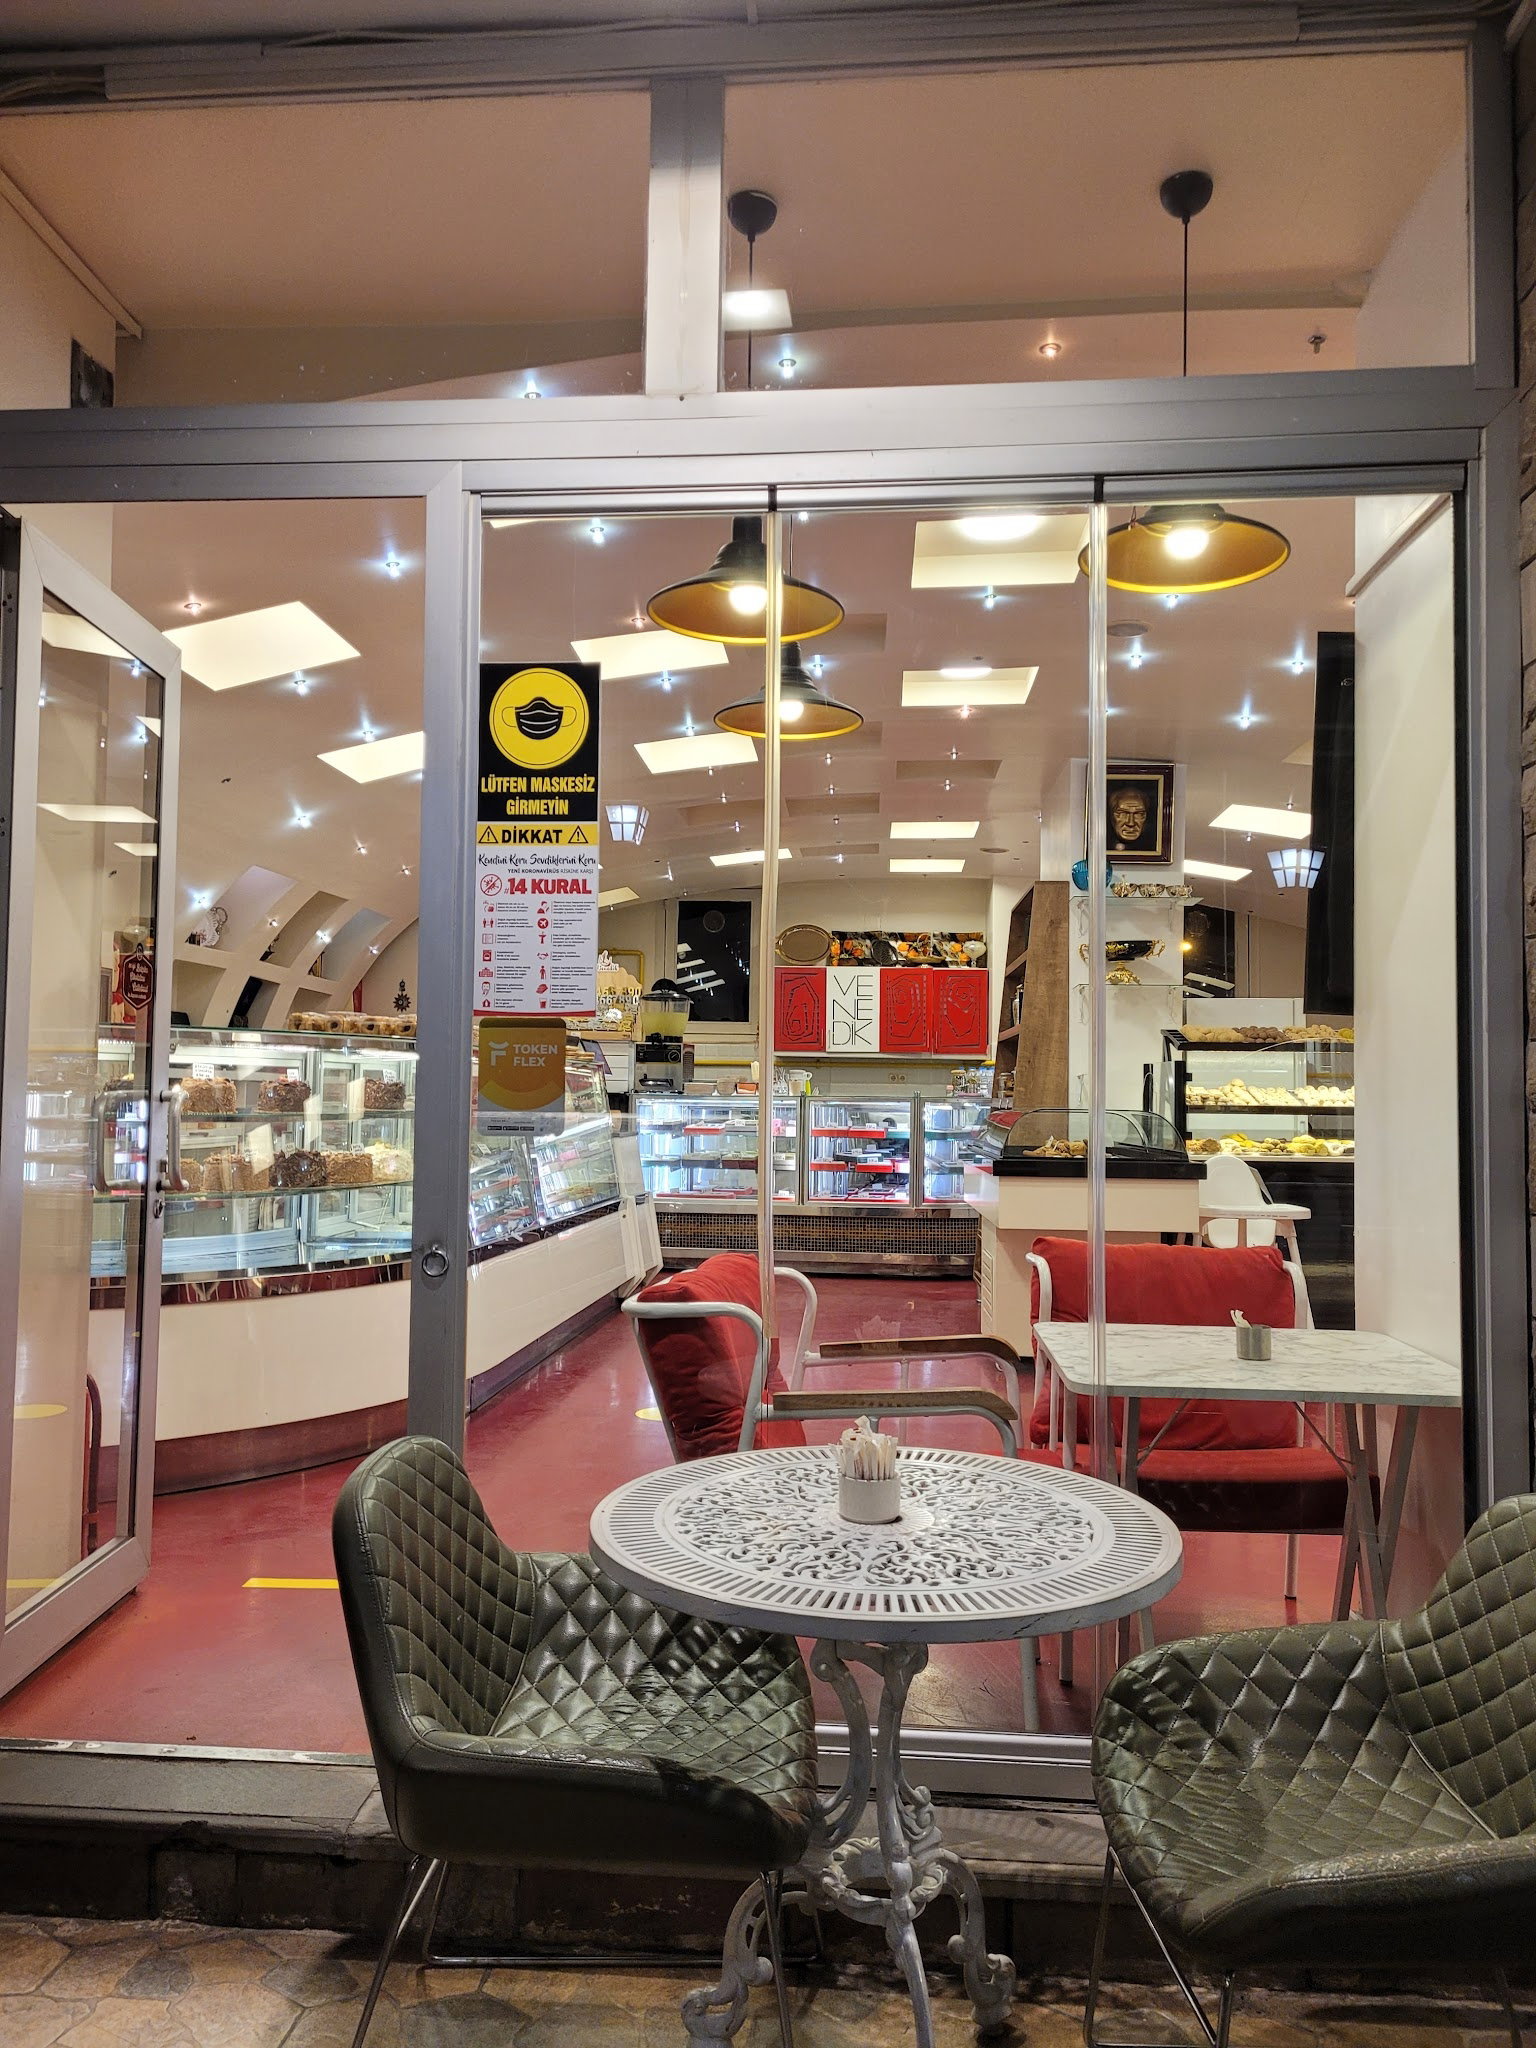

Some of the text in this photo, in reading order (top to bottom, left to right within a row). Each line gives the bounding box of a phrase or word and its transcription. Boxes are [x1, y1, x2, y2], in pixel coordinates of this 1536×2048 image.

[481, 773, 596, 793] LÜTFEN MASKESİZ
[506, 796, 569, 816] GİRMEYİN
[501, 825, 563, 844] DİKKAT
[478, 853, 508, 867] Kendini
[509, 853, 528, 867] Koru
[578, 853, 596, 867] Koru
[531, 878, 592, 895] KURAL
[513, 1044, 558, 1055] TOKEN
[513, 1056, 546, 1067] FLEX
